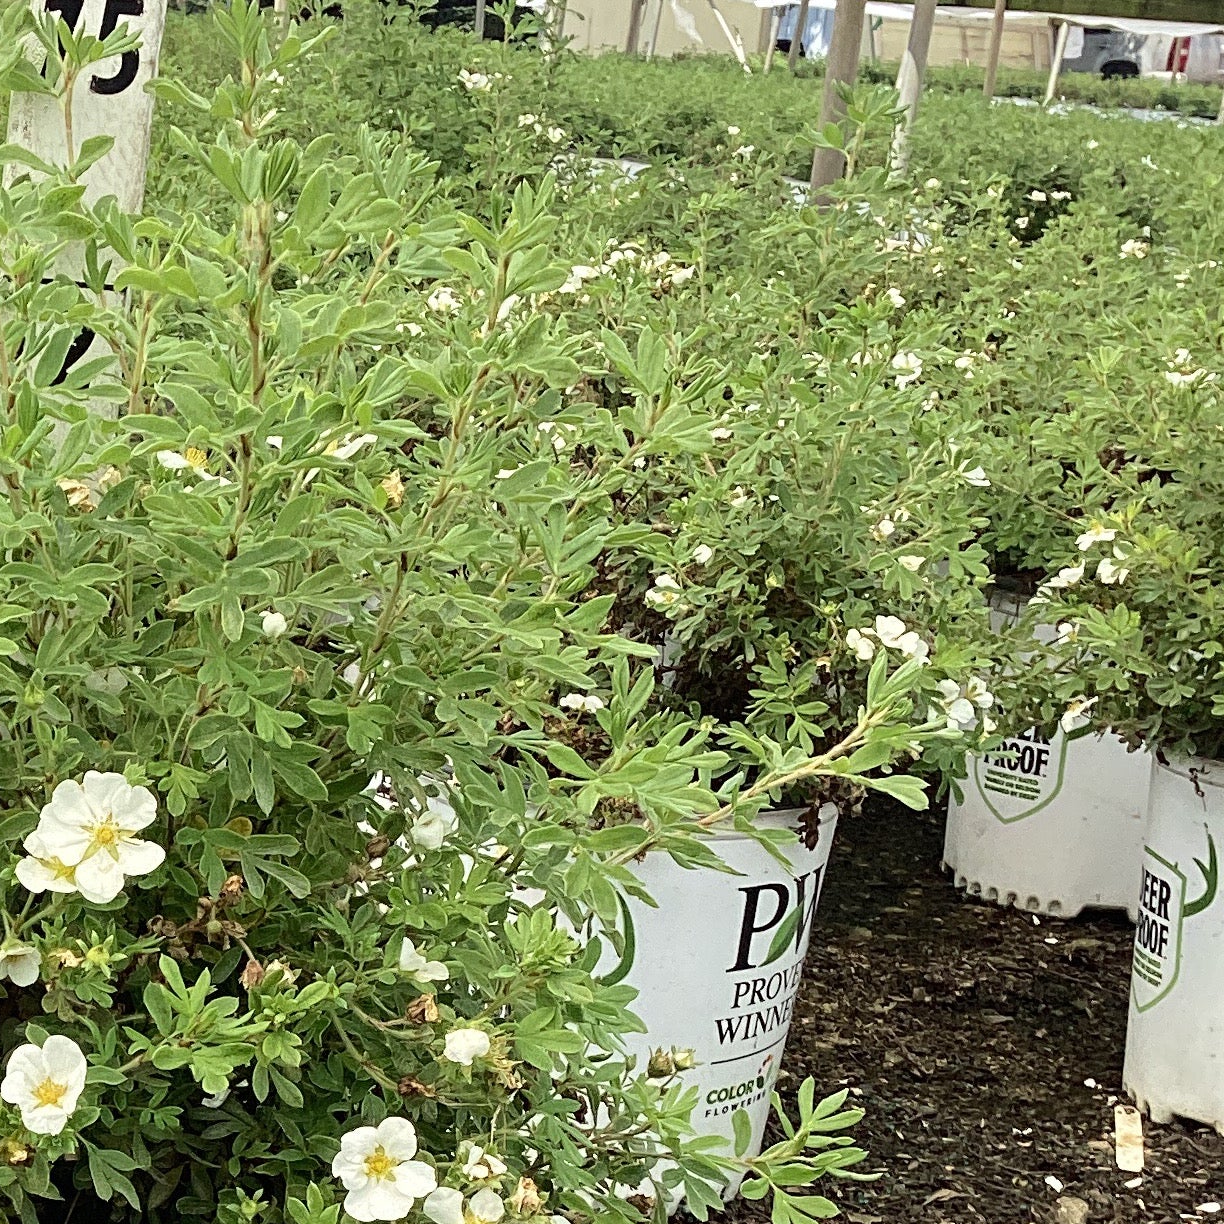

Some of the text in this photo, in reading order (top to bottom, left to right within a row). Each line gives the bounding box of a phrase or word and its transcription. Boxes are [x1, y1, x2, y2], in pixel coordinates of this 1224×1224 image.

[1140, 866, 1171, 922] EER
[715, 994, 796, 1045] WINNE
[706, 1079, 755, 1104] COLOR
